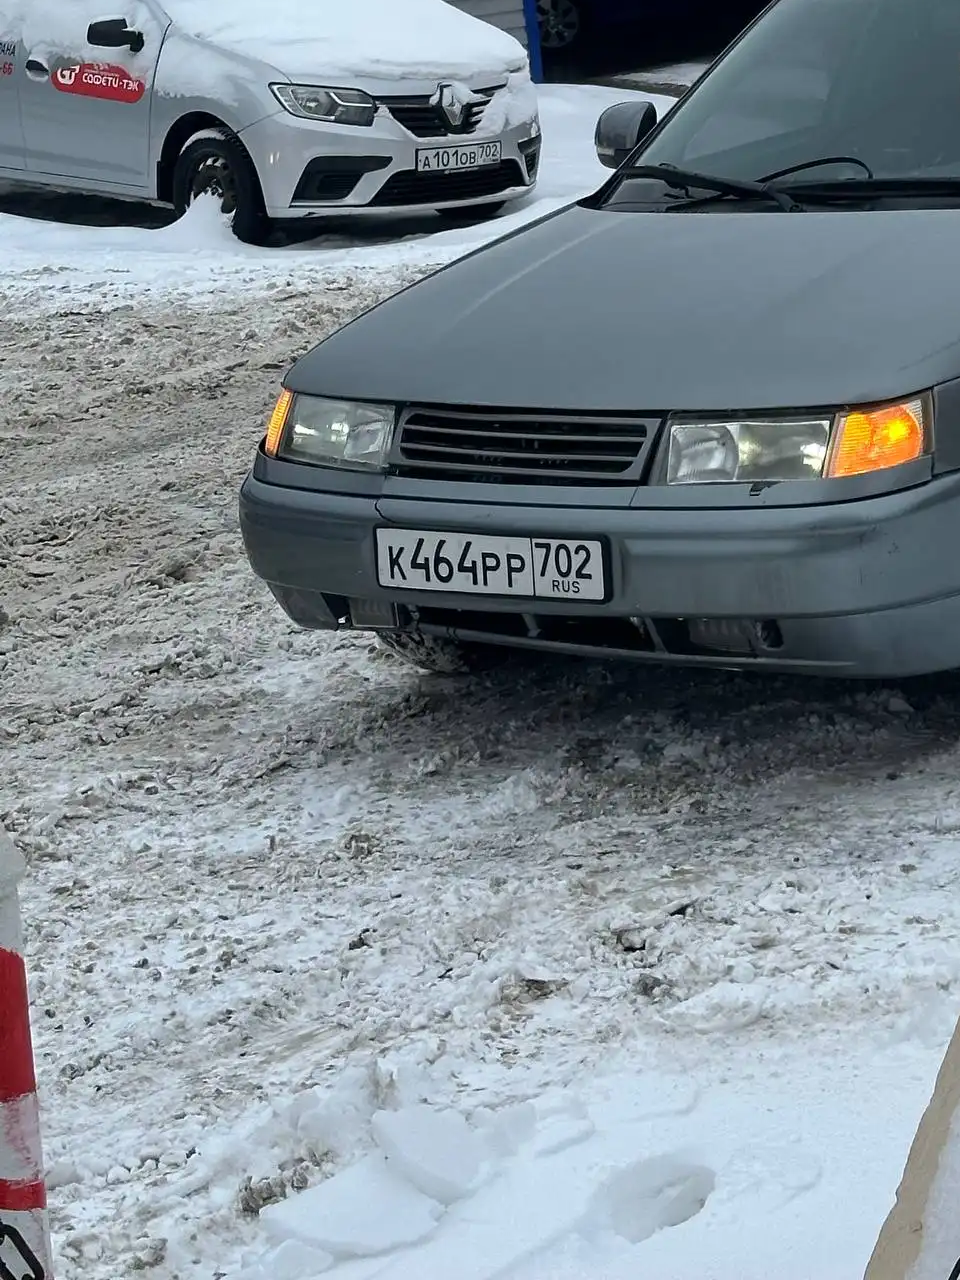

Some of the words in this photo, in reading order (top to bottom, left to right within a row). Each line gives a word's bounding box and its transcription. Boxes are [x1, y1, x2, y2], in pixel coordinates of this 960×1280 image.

[422, 150, 477, 169] А101ОВ
[479, 144, 498, 158] 702
[388, 538, 526, 587] К464РР
[534, 543, 593, 580] 702
[552, 580, 581, 593] RUS
